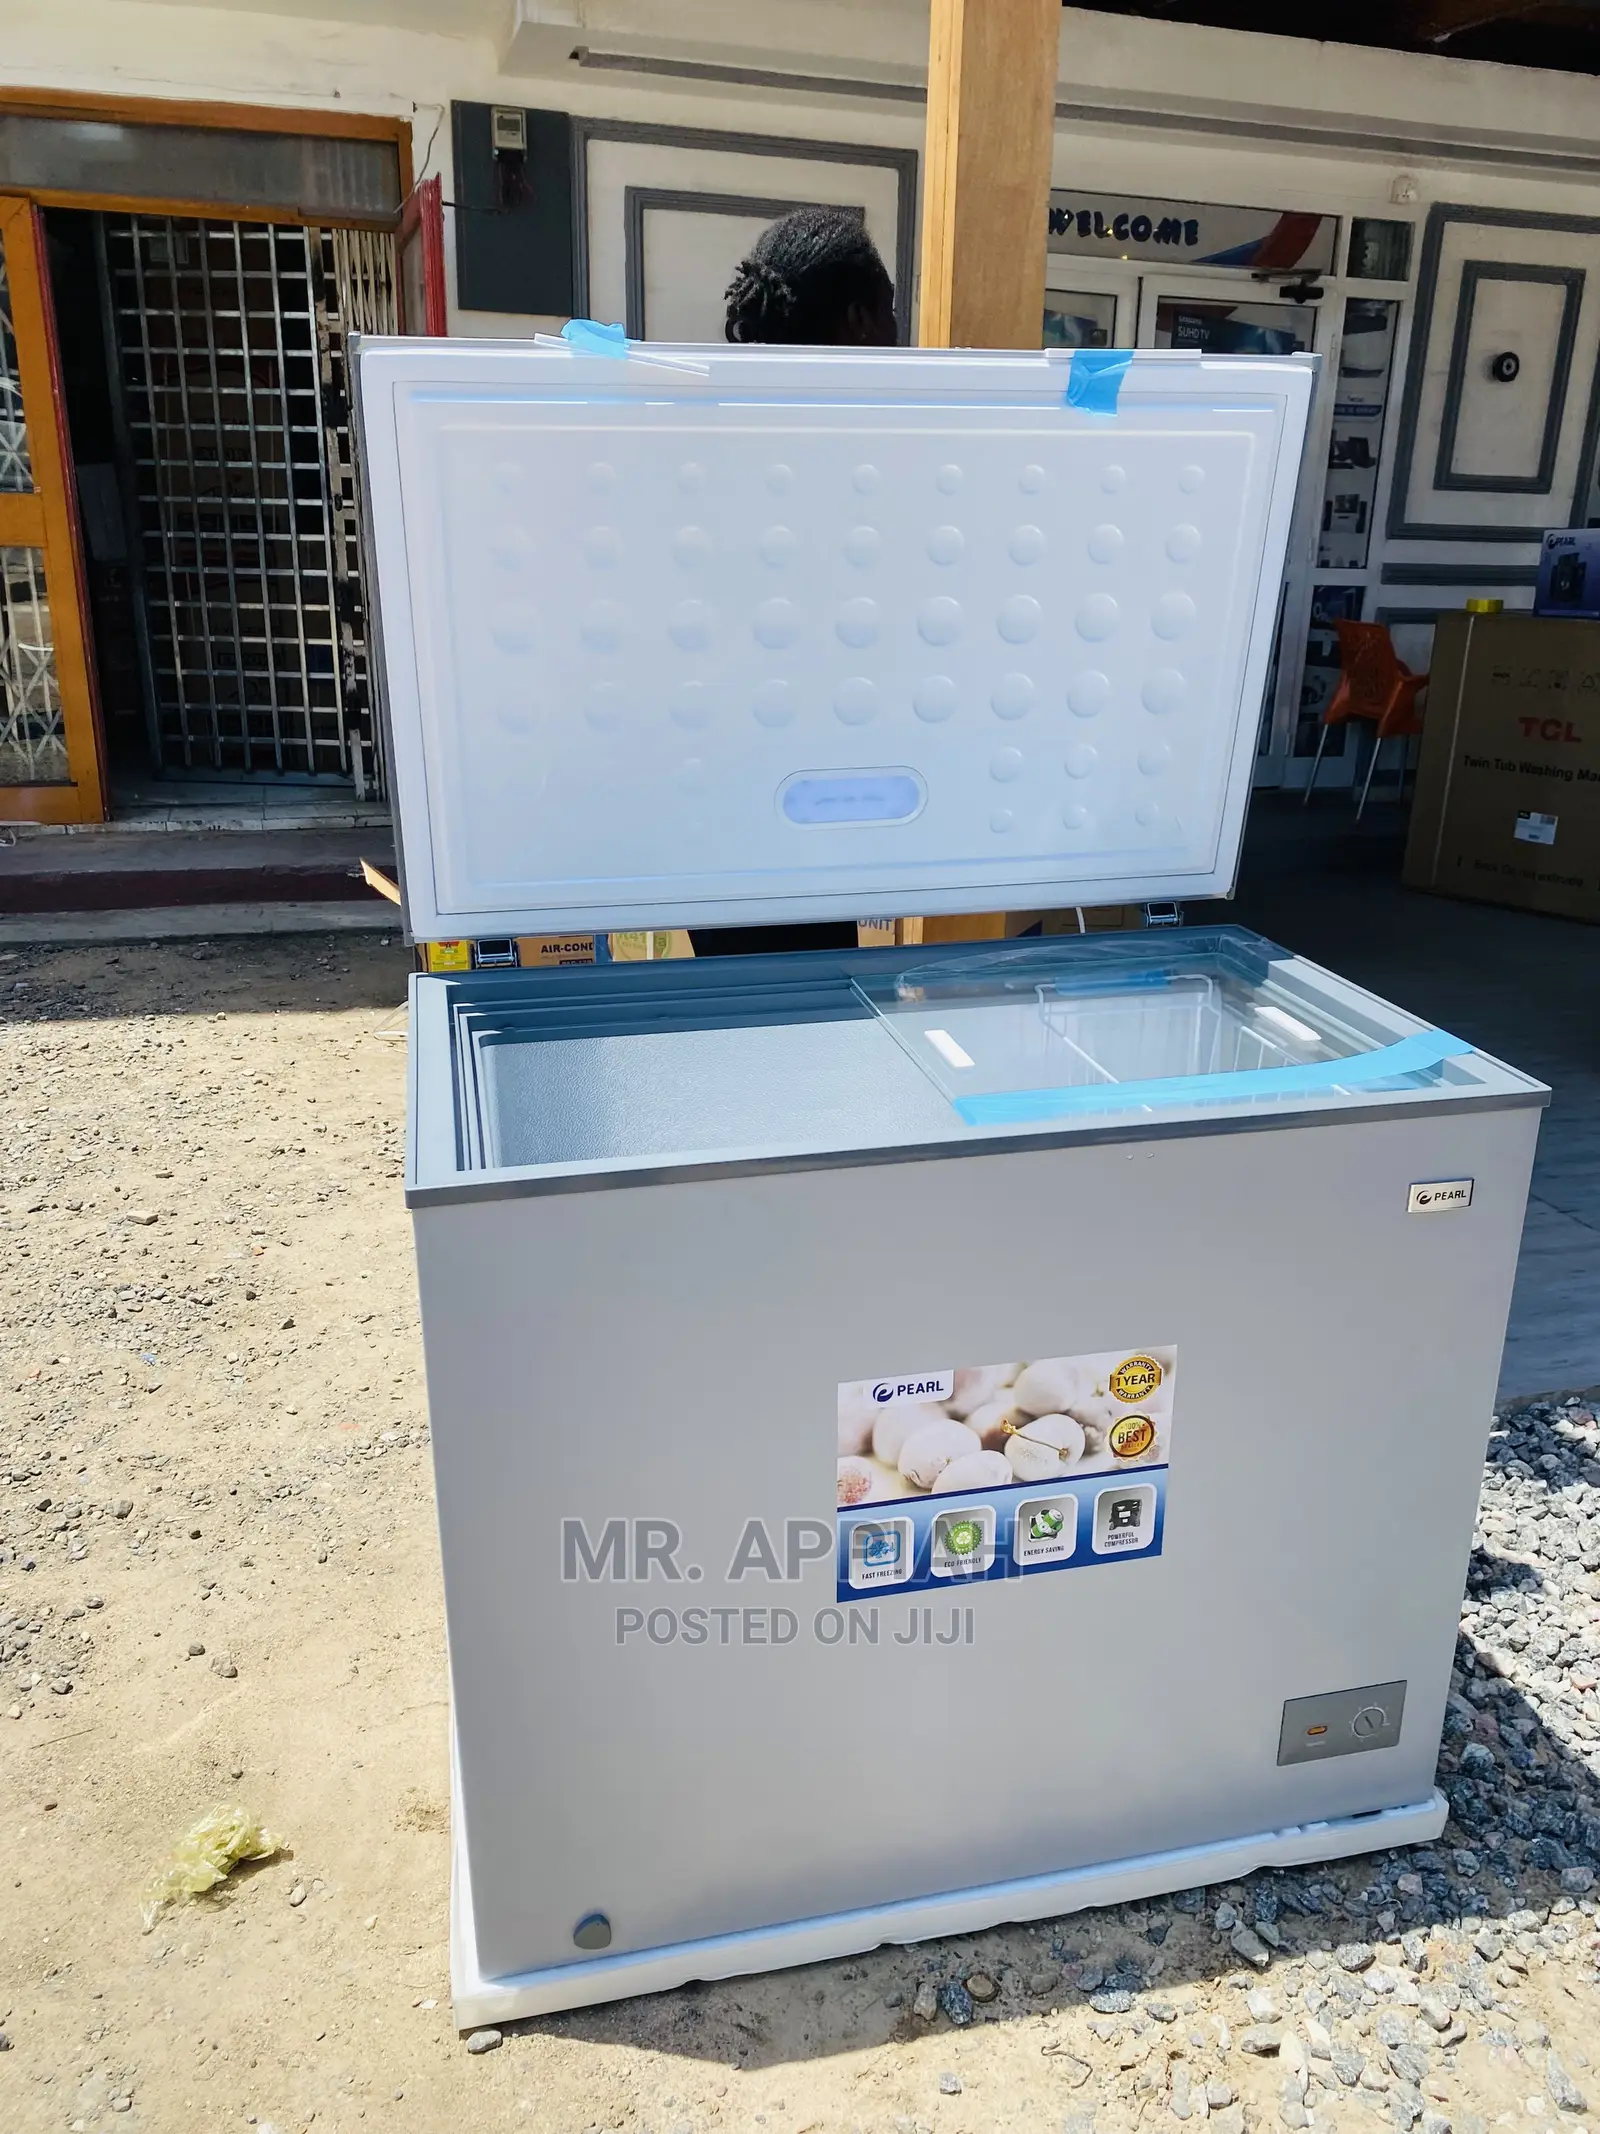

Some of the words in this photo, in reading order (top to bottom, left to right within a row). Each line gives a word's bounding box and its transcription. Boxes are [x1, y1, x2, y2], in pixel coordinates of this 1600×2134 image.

[1049, 207, 1199, 246] WELCOME
[1200, 328, 1211, 340] TV
[1518, 716, 1582, 743] TCL
[1464, 755, 1490, 770] Twin
[1494, 758, 1516, 773] Tub
[1519, 763, 1573, 782] Washing
[1434, 1190, 1467, 1201] PEARL
[1119, 1360, 1155, 1375] WARRANTY
[1115, 1377, 1121, 1387] 1
[1123, 1373, 1156, 1386] YEAR
[897, 1380, 944, 1396] PEARL
[1117, 1386, 1152, 1399] WARRANTY
[1118, 1429, 1147, 1445] BEST
[1104, 1537, 1139, 1548] COMPRESSOR
[1107, 1531, 1134, 1541] POWERFUL
[1023, 1548, 1044, 1557] ENERGY
[1045, 1545, 1065, 1554] SAVING
[862, 1571, 876, 1580] FAST
[876, 1568, 903, 1577] FREEZING
